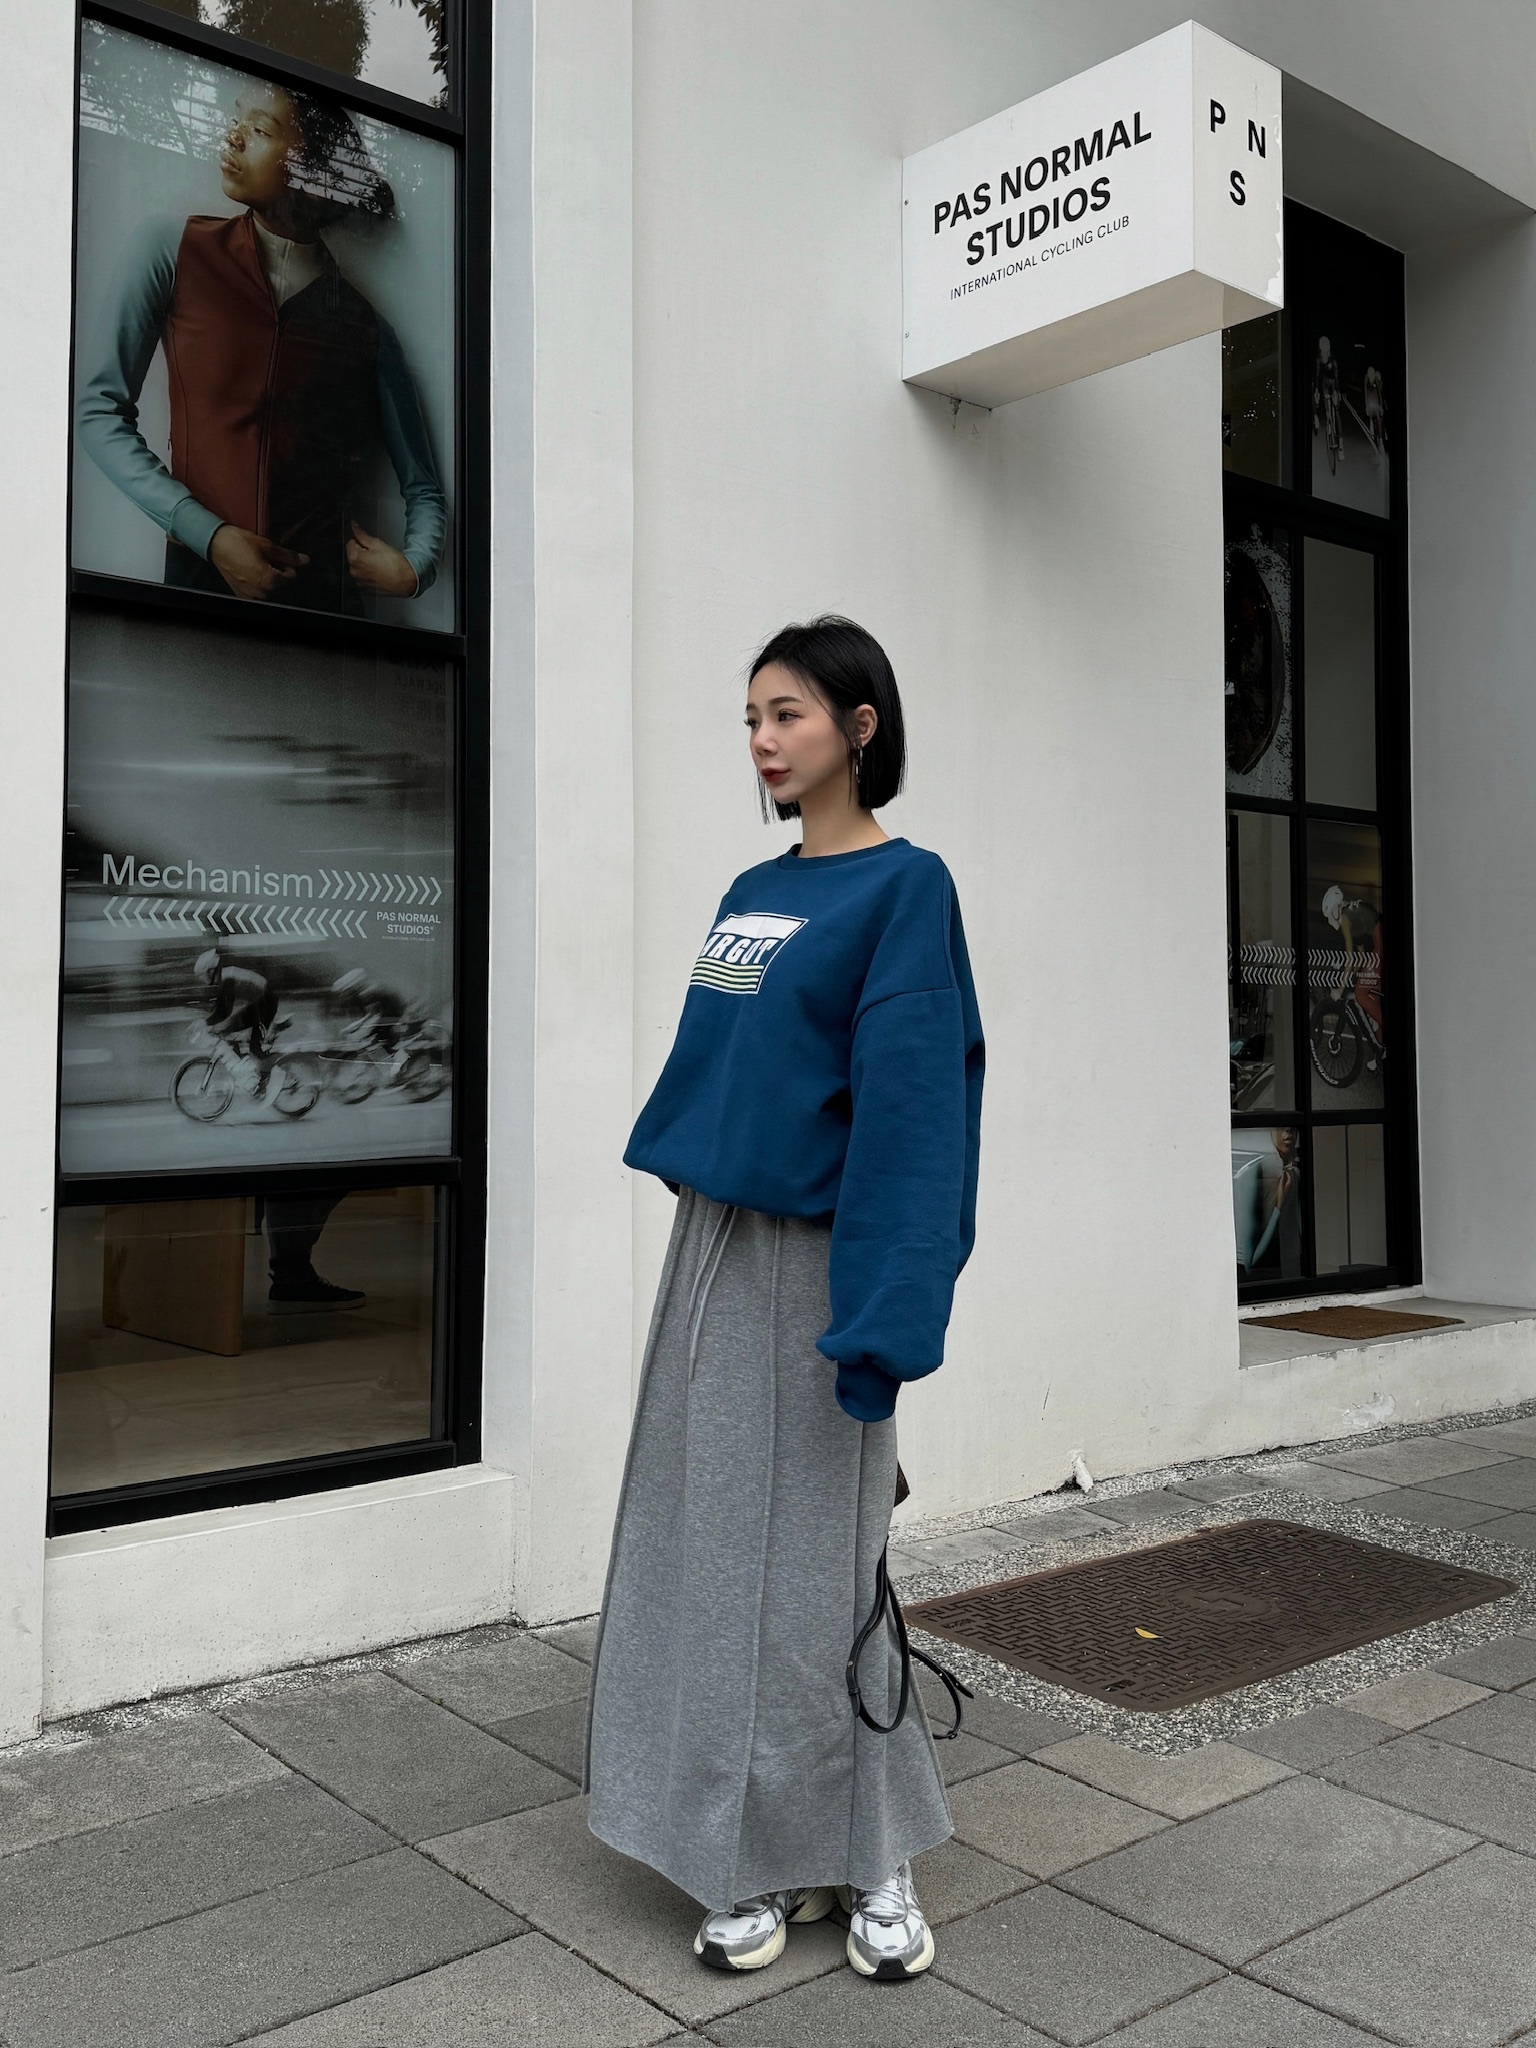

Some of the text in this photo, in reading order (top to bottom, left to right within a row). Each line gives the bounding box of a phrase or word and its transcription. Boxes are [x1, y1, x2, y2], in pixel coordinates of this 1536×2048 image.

[1210, 98, 1266, 159] P N
[934, 111, 1152, 235] PAS NORMAL
[1230, 169, 1246, 206] S
[966, 176, 1111, 266] STUDIOS
[950, 215, 1130, 300] INTERNATIONAL CYCLING CLUB
[102, 853, 314, 899] Mechanism
[376, 911, 441, 924] PAS NORMAL
